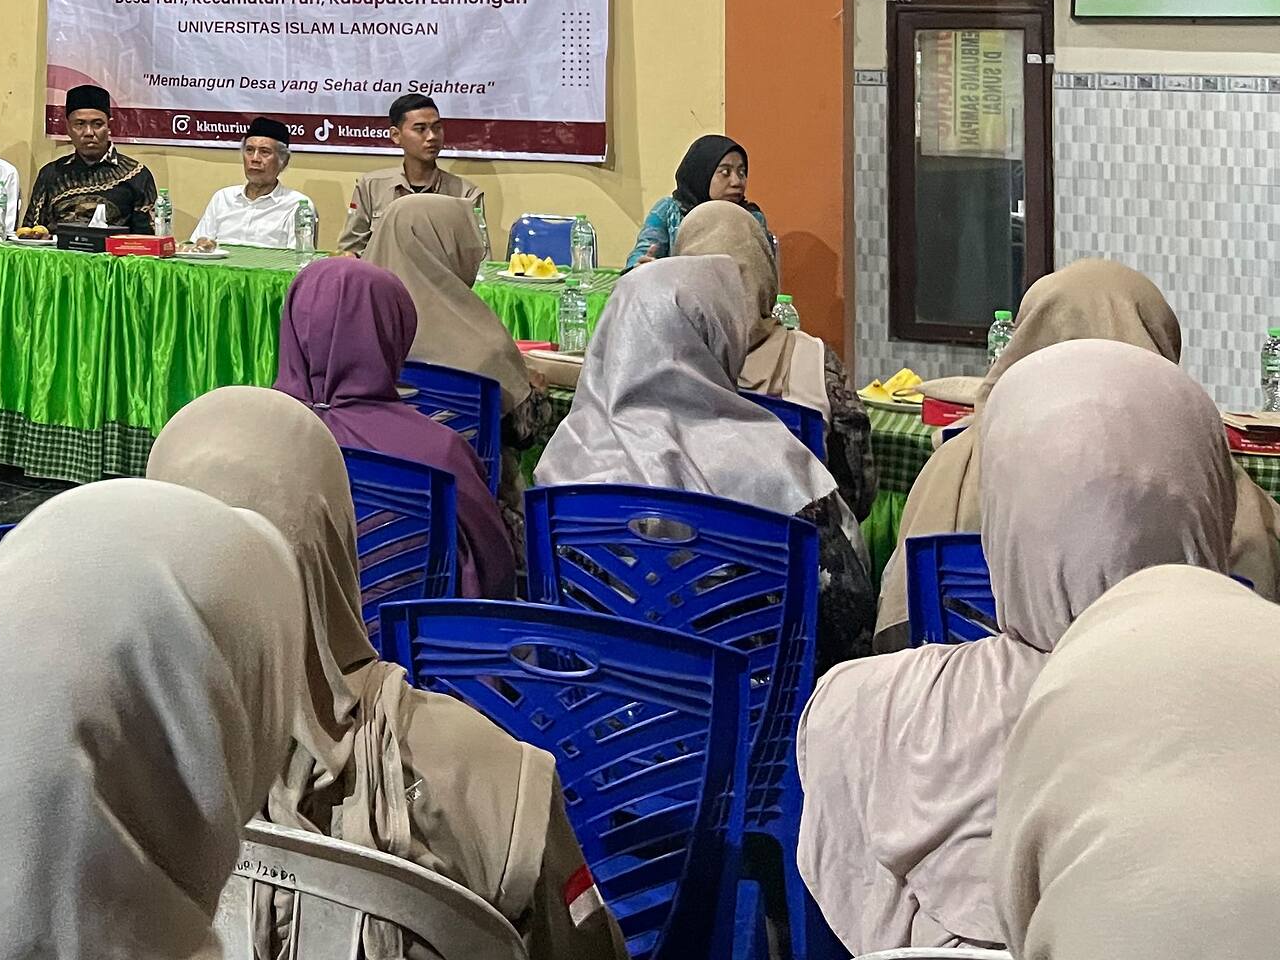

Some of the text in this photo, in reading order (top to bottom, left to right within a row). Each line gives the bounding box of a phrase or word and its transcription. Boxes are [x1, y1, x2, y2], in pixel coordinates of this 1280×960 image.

[178, 21, 439, 35] UNIVERSITAS ISLAM LAMONGAN
[143, 74, 495, 96] "Membangun Desa yang Sehat dan Sejahtera"
